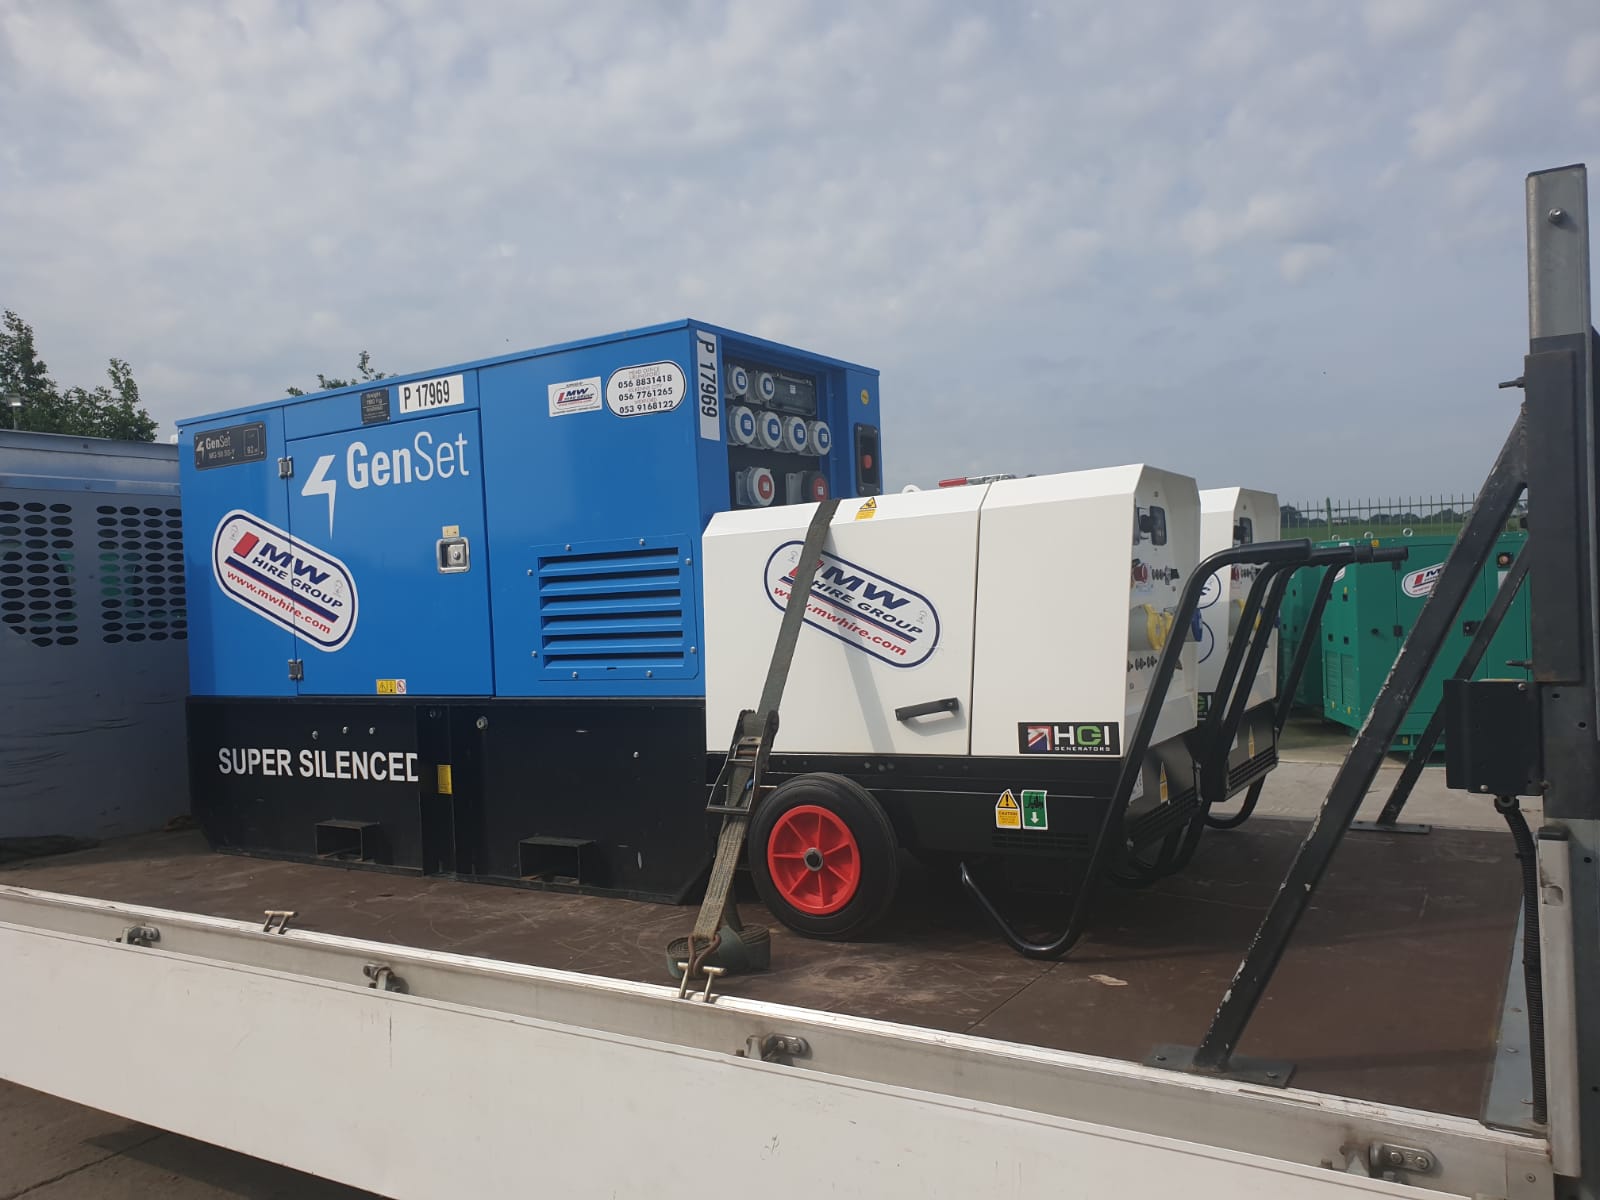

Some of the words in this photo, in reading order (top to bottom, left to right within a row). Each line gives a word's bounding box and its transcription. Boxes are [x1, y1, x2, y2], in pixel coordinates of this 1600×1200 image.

[698, 340, 715, 354] P
[403, 386, 411, 410] P
[416, 379, 450, 407] 17969
[566, 387, 589, 397] MW
[618, 381, 633, 389] 056
[636, 374, 673, 386] 8831418
[618, 393, 634, 402] 056
[637, 387, 673, 399] 7761265
[700, 362, 718, 418] 17969
[619, 406, 634, 414] 053
[637, 400, 674, 412] 9168122
[205, 435, 231, 450] GenSet
[347, 431, 470, 490] GenSet
[259, 543, 330, 585] MW
[252, 557, 288, 580] HIRE
[291, 578, 343, 608] GROUP
[821, 566, 911, 610] MW
[227, 571, 331, 634] www.mwhire.com
[812, 580, 855, 603] HIRE
[857, 602, 923, 634] GROUP
[774, 587, 907, 656] w.mwhire.com
[1054, 725, 1110, 746] HGI
[218, 747, 293, 777] SUPER
